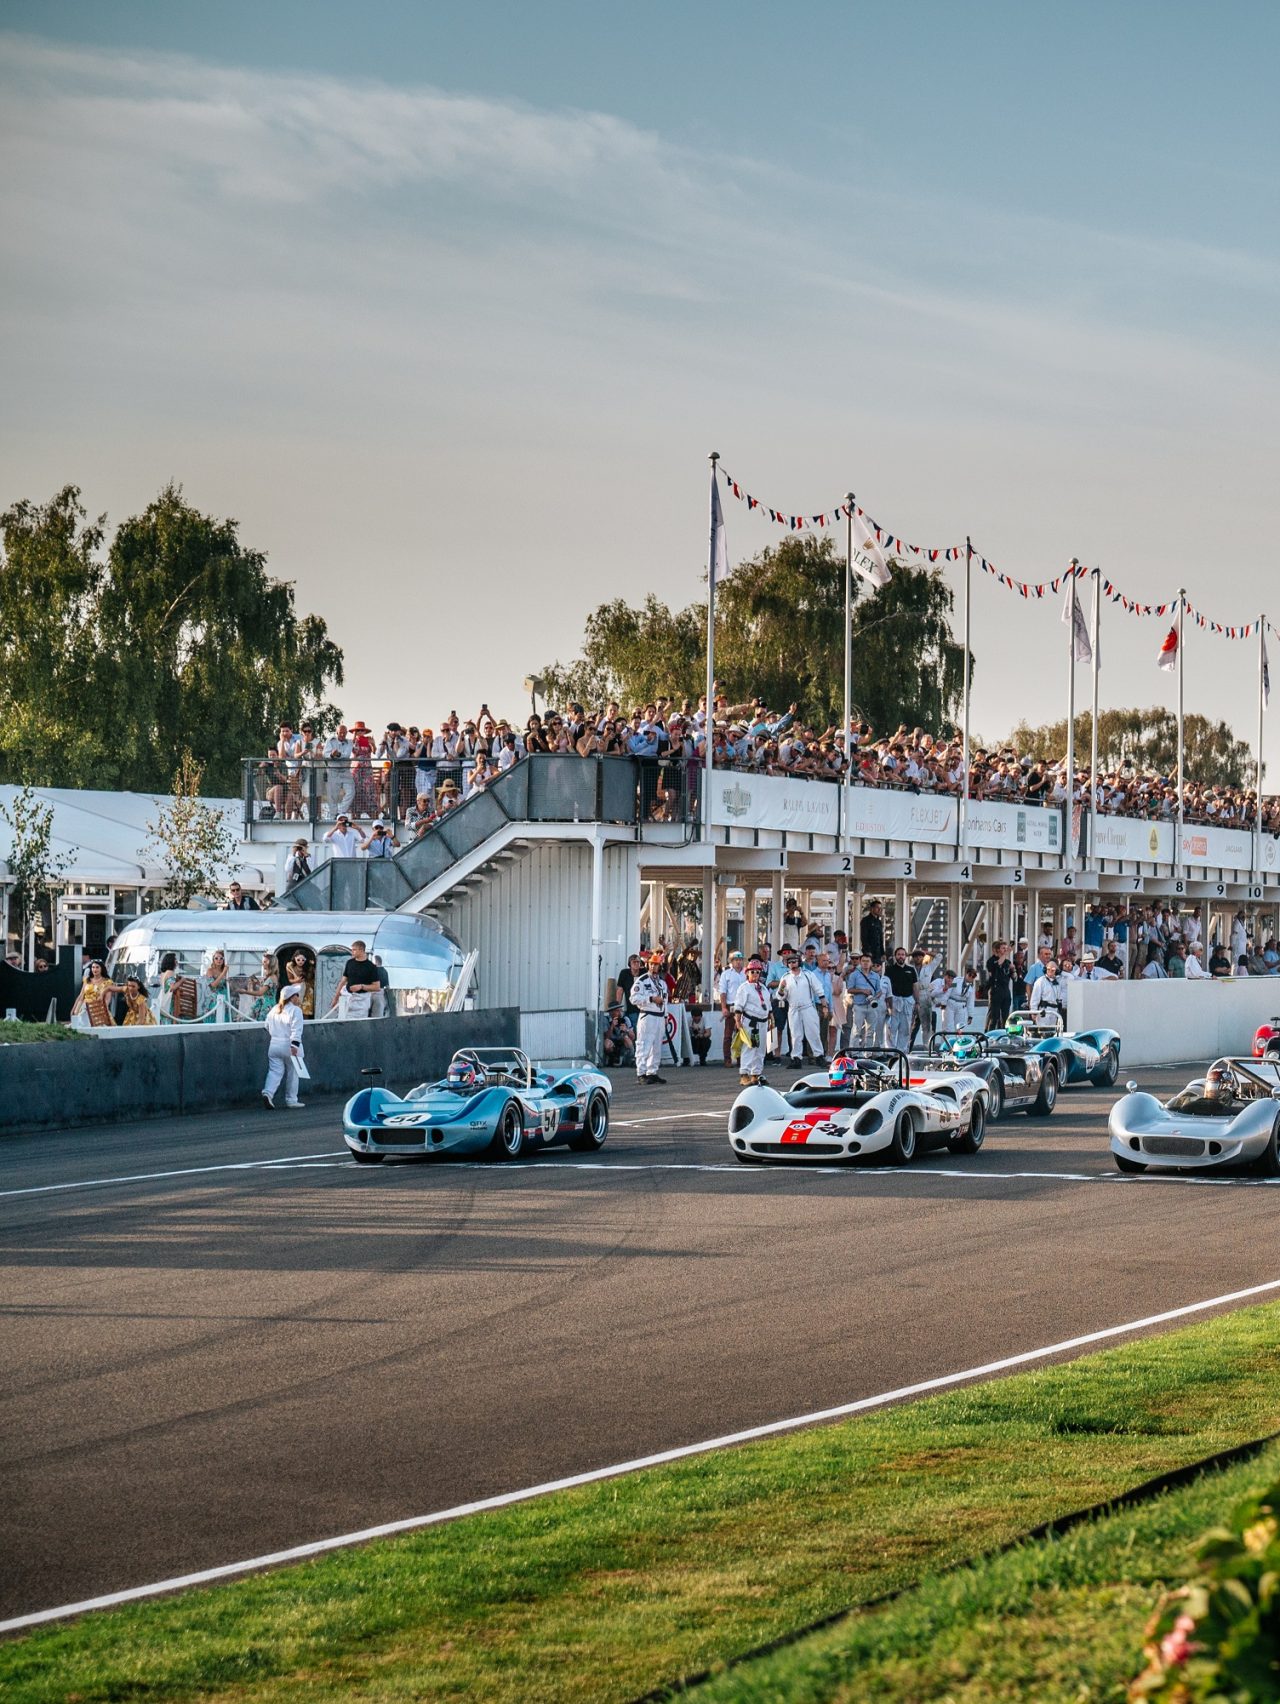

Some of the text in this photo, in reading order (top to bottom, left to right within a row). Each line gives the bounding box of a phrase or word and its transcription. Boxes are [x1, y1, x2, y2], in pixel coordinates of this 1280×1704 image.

[780, 853, 784, 866] 1
[842, 857, 851, 871] 2
[904, 862, 912, 875] 3
[961, 866, 969, 878] 4
[1014, 870, 1022, 882] 5
[1064, 873, 1072, 885] 6
[1133, 878, 1140, 889] 7
[1176, 882, 1183, 892] 8
[1217, 885, 1224, 895] 9
[1248, 887, 1261, 898] 10
[389, 1114, 423, 1124] 54
[544, 1107, 556, 1132] 54
